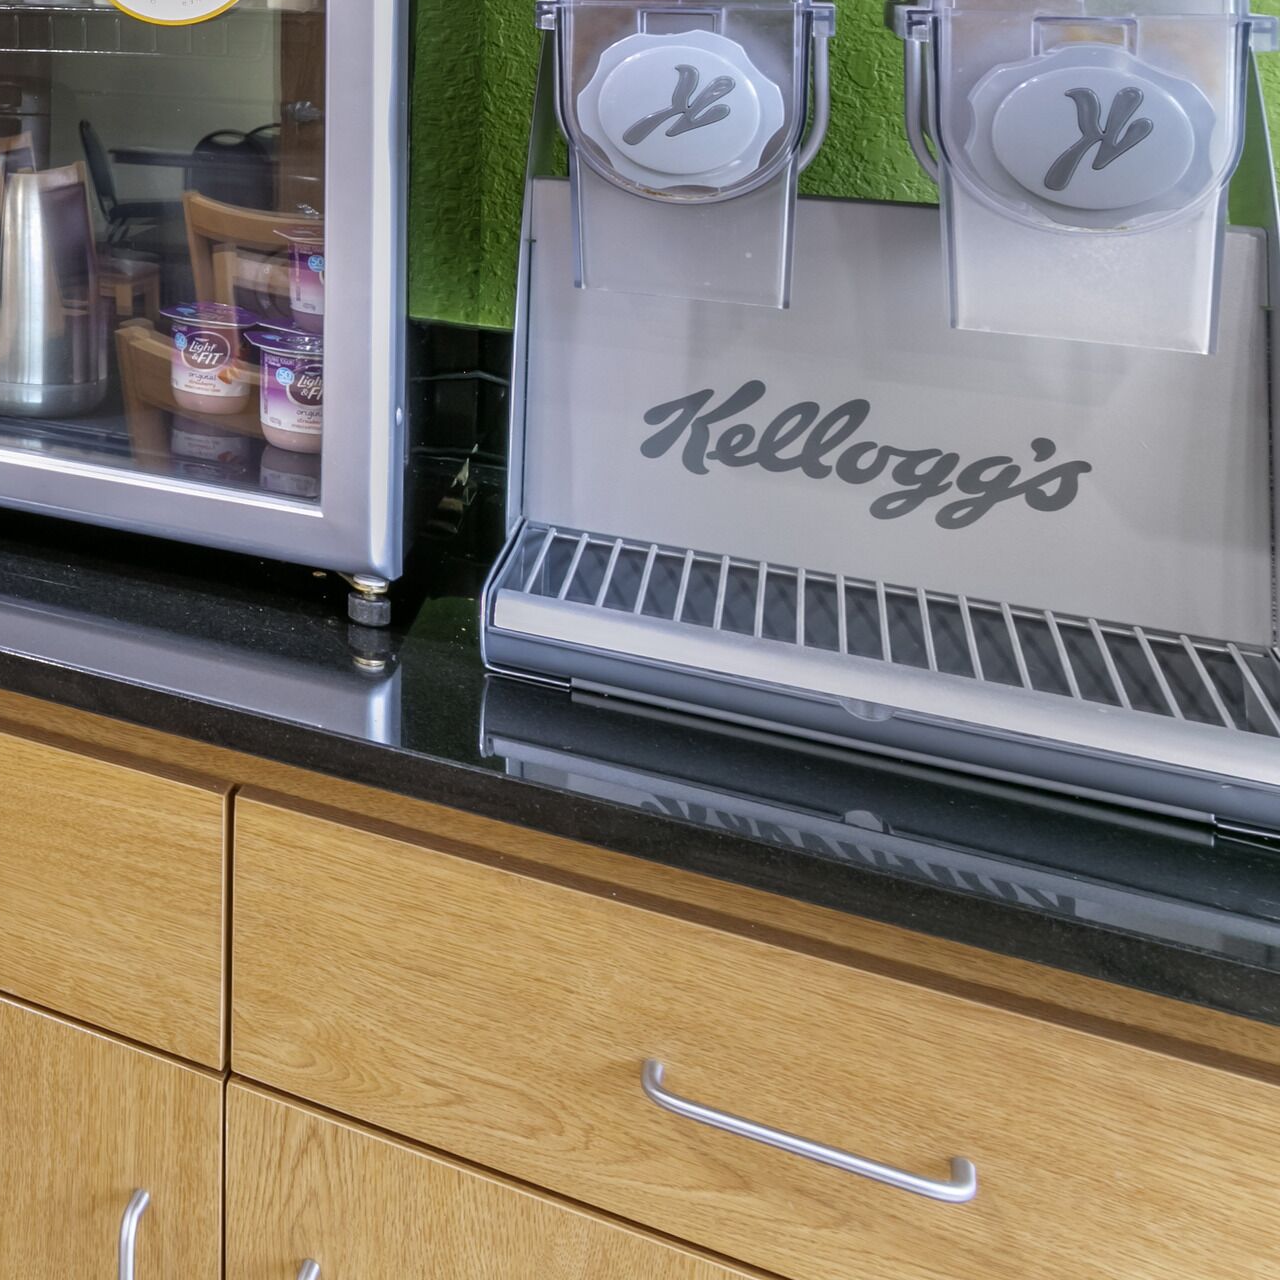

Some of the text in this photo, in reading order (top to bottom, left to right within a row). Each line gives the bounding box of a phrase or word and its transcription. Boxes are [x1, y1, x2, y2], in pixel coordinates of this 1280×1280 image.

[189, 340, 216, 354] Light
[188, 372, 217, 382] original
[297, 375, 322, 389] Ligh
[640, 379, 1093, 530] Kellogg's
